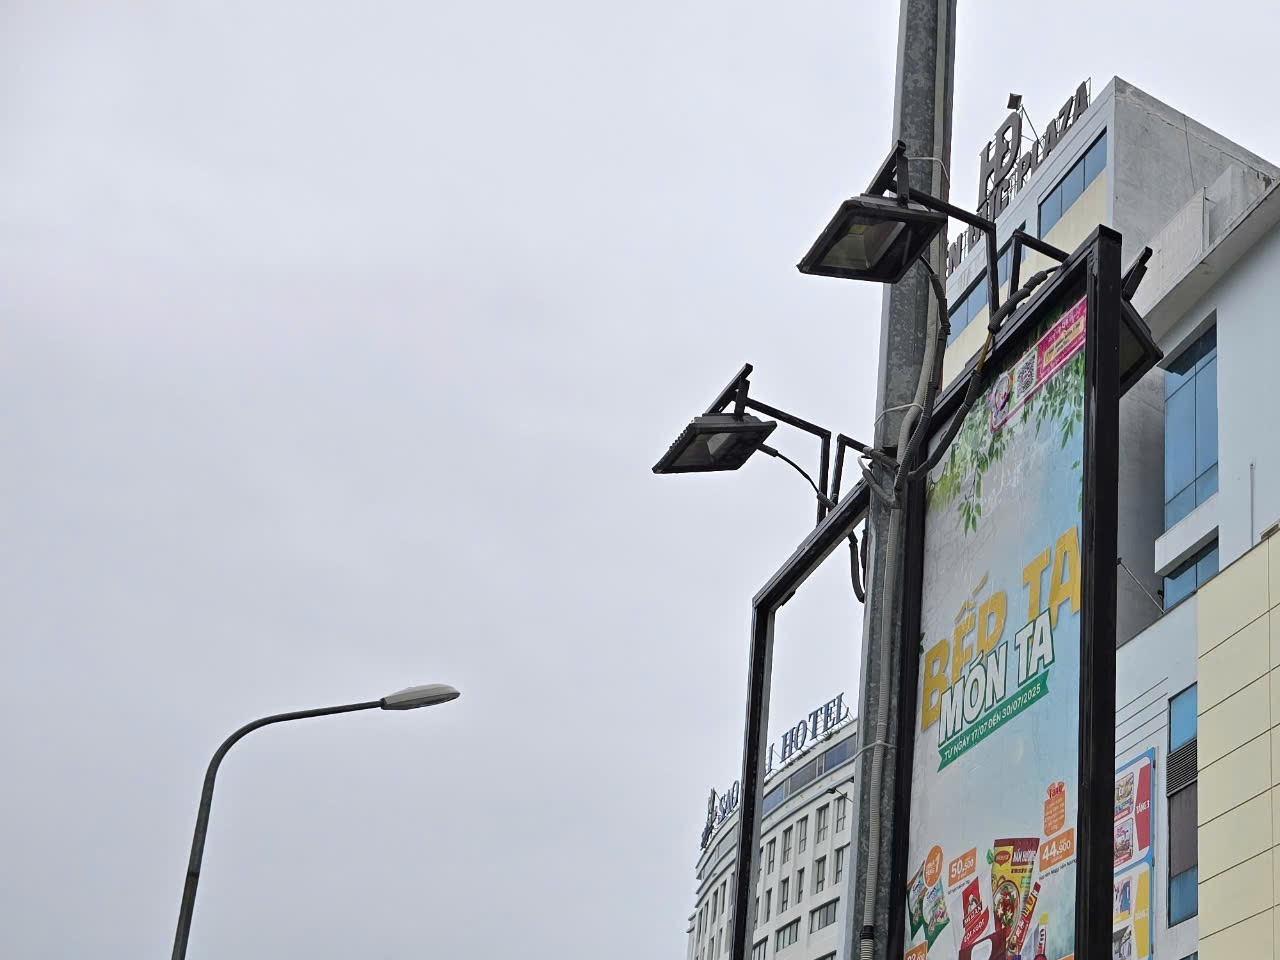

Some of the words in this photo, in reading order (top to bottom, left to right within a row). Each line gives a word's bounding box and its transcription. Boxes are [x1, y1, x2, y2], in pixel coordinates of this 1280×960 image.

[921, 571, 1007, 731] BẾP
[1022, 526, 1081, 628] TA
[937, 642, 1010, 748] MÓN
[1015, 607, 1056, 684] TA
[780, 692, 849, 763] HOTEL
[1001, 682, 1041, 719] 30/07/2025
